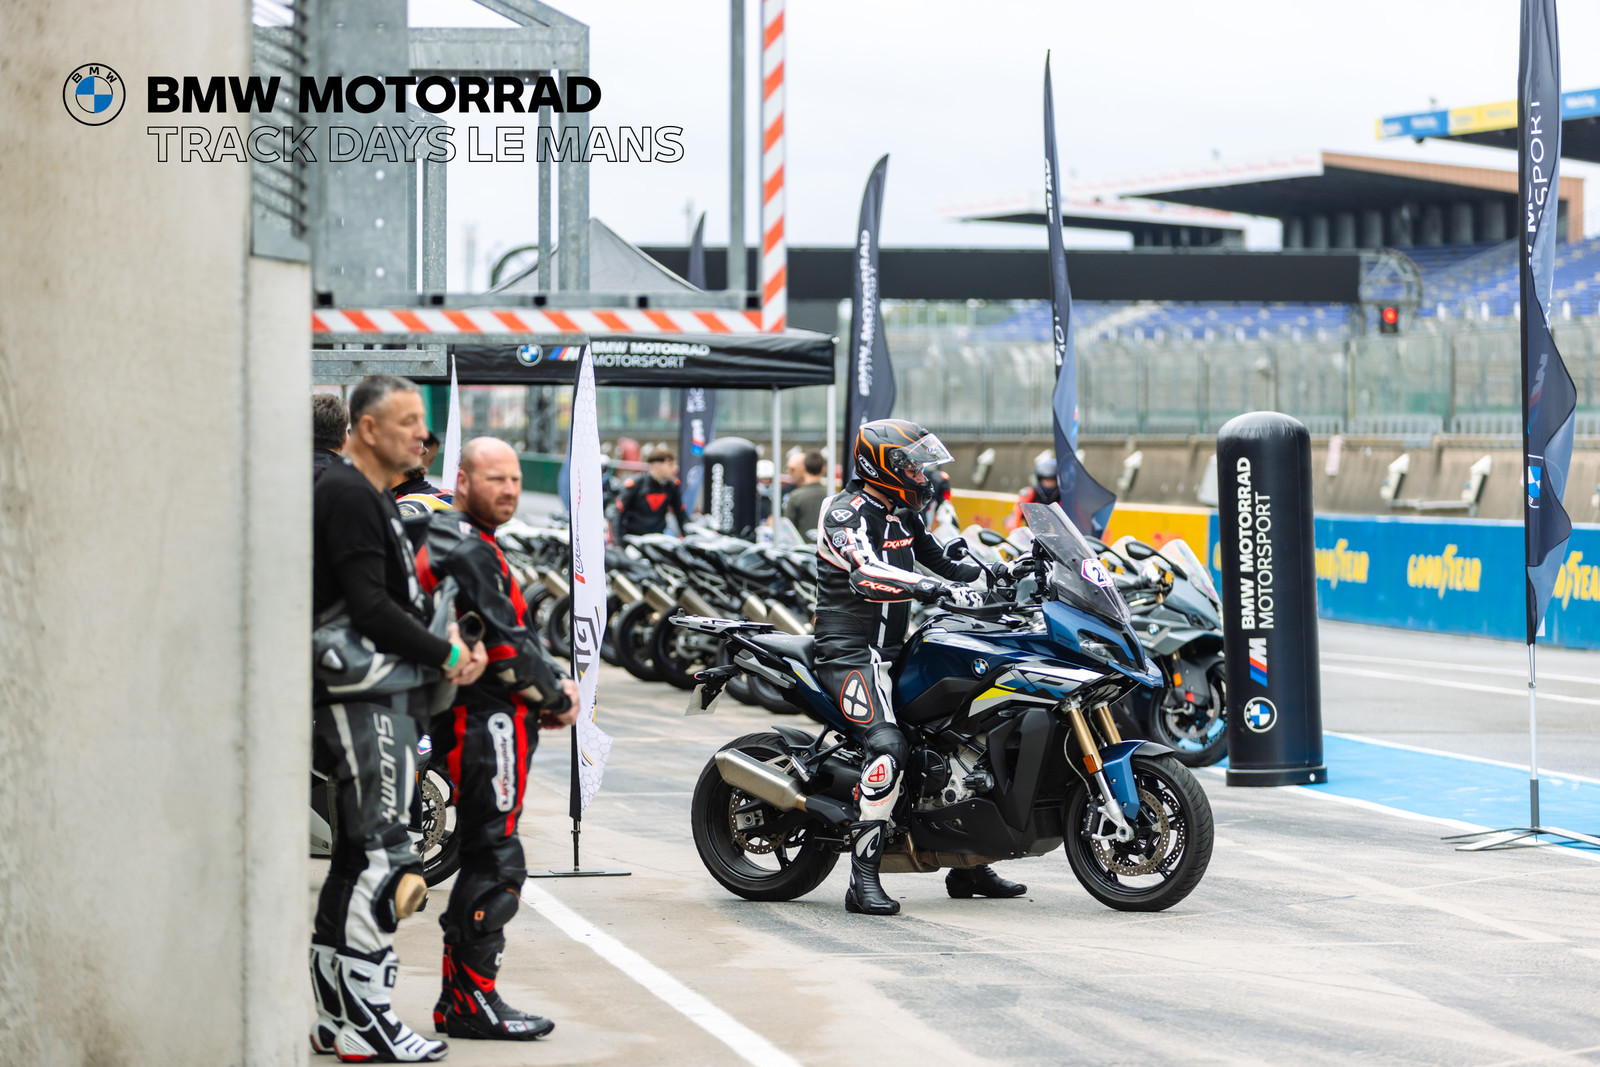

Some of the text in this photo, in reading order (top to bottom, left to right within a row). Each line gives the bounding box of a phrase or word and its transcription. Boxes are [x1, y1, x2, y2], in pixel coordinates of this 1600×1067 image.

[591, 341, 628, 354] BMW
[631, 342, 711, 357] MOTORRAD
[592, 354, 687, 368] MOTORSPORT
[1236, 457, 1254, 573] MOTORRAD
[1255, 491, 1274, 629] MOTORSPORT
[1315, 538, 1369, 590] OODYEAR
[1407, 543, 1481, 599] GOODYEAR
[857, 580, 904, 595] IXON
[1241, 577, 1256, 630] BMW
